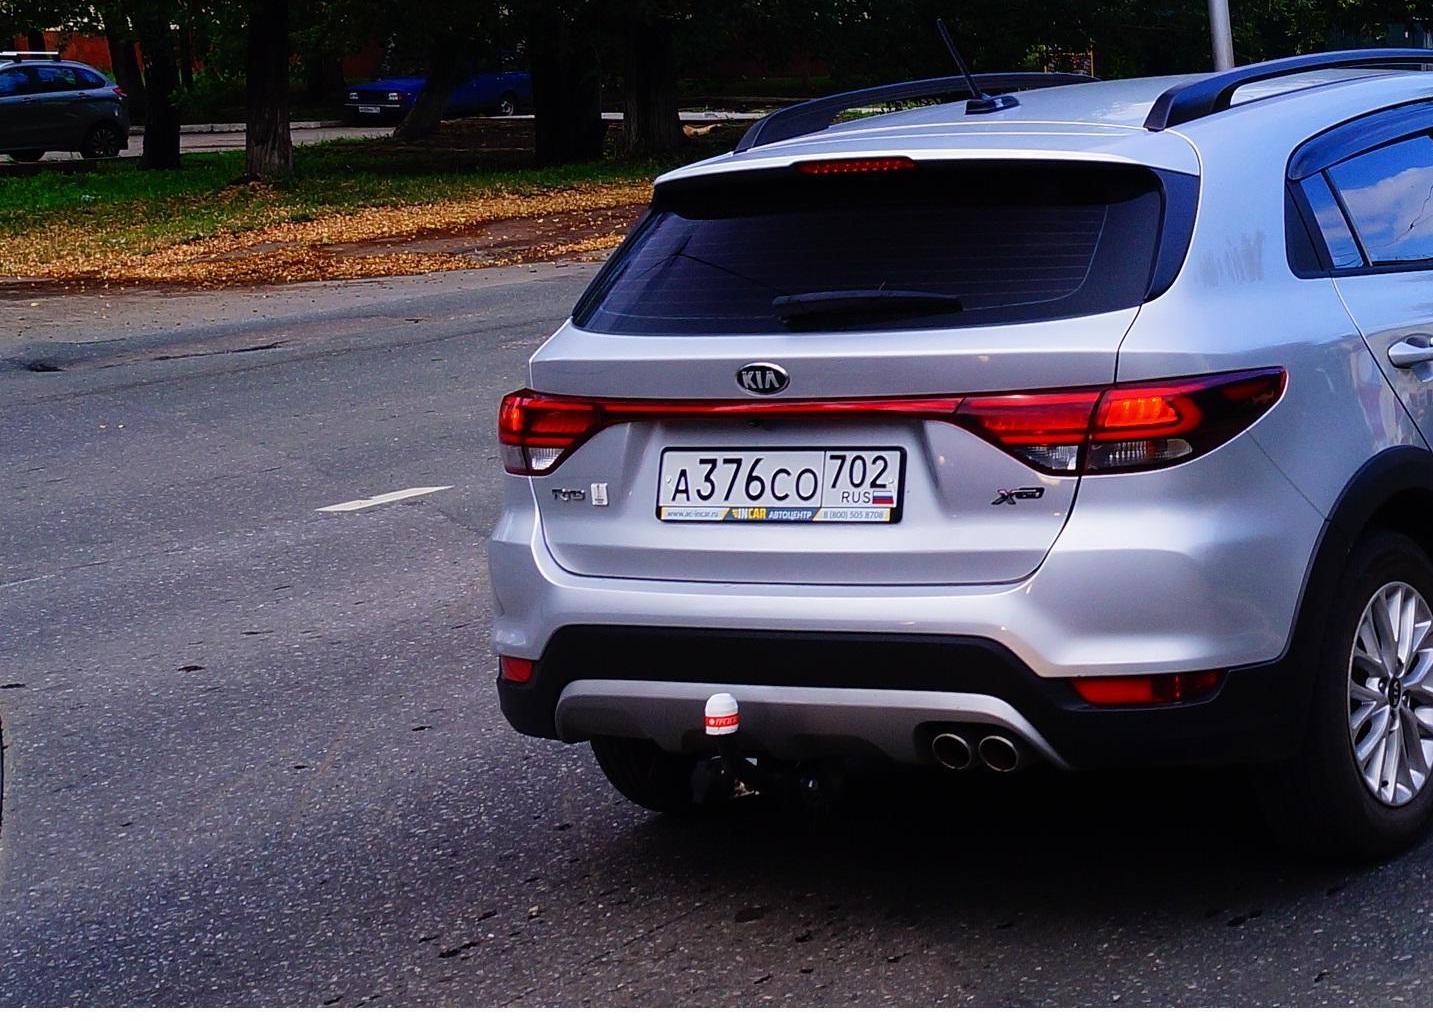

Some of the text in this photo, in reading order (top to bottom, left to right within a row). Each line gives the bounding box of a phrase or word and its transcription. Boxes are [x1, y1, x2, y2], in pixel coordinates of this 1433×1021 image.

[741, 370, 780, 389] KIA
[671, 454, 889, 501] А376СО 702
[841, 491, 871, 504] RUS
[738, 507, 812, 520] INCAR АВТОЦЕНТР
